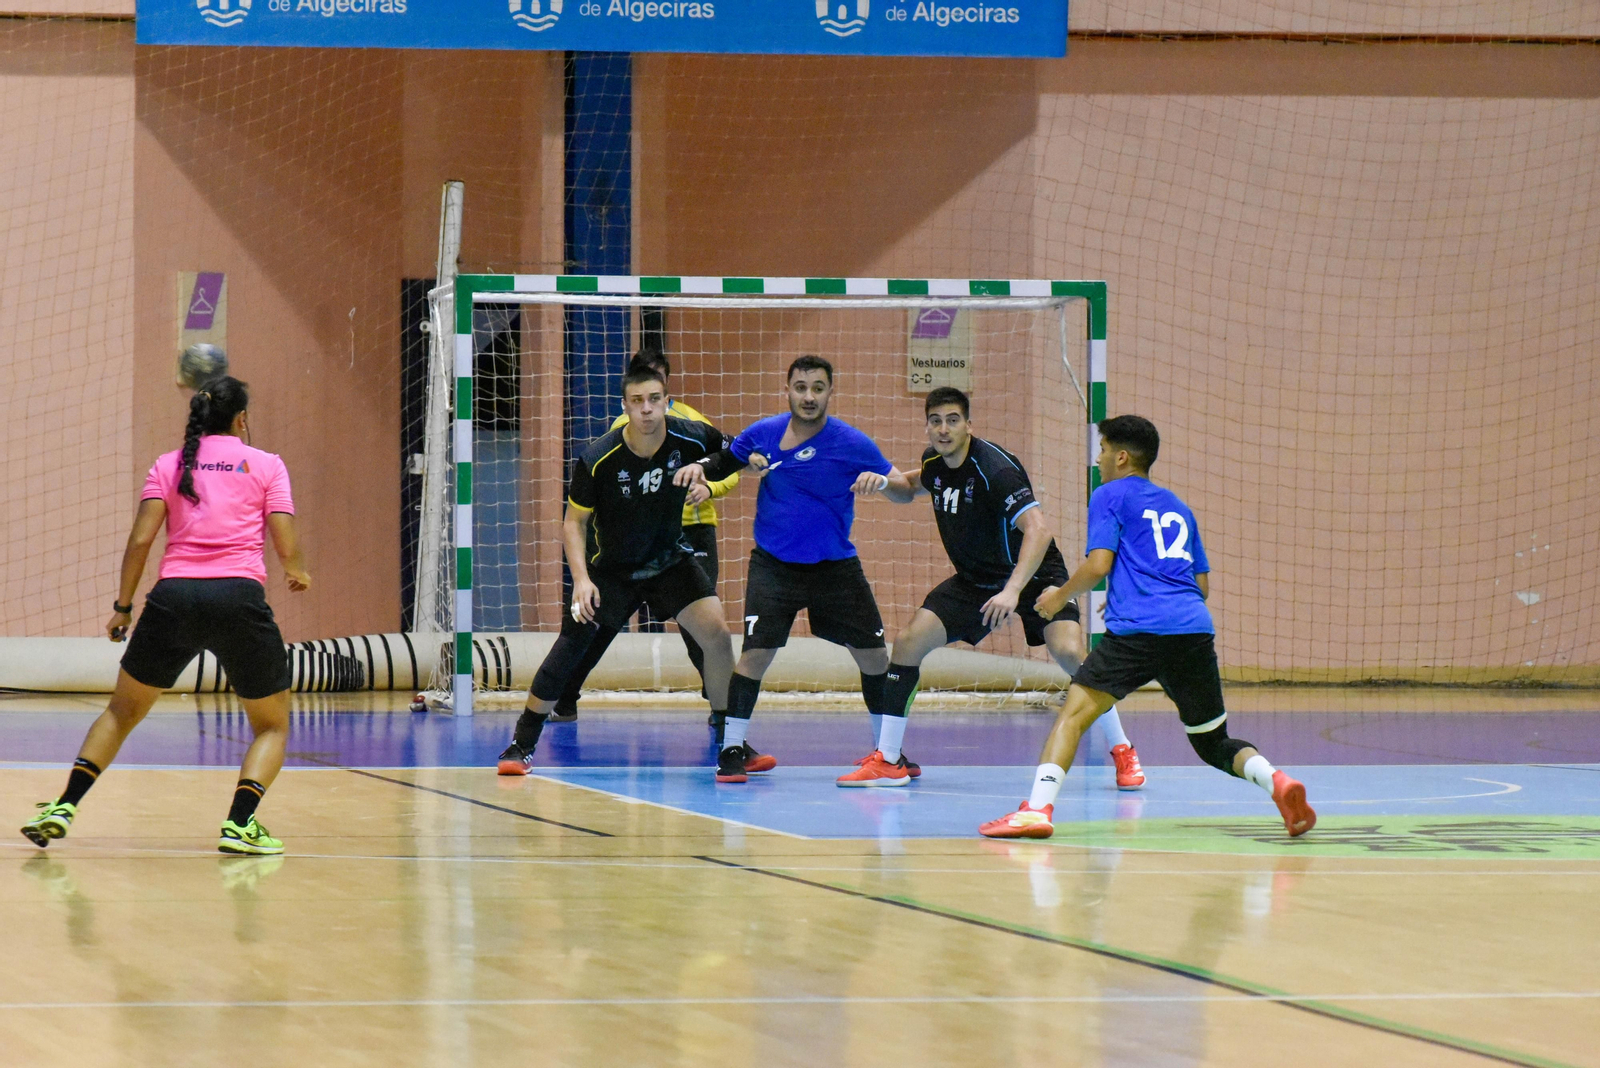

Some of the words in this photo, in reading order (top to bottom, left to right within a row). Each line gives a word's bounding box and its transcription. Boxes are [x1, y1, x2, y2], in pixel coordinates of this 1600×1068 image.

[268, 0, 291, 12] de
[579, 0, 601, 16] de
[606, 0, 715, 22] Algeciras
[886, 5, 907, 21] de
[912, 1, 1020, 27] Algeciras
[911, 357, 966, 368] Vestuarios
[911, 373, 933, 384] C-D
[638, 467, 663, 495] 19
[942, 486, 960, 514] 11
[1142, 509, 1195, 563] 12
[745, 615, 759, 636] 7
